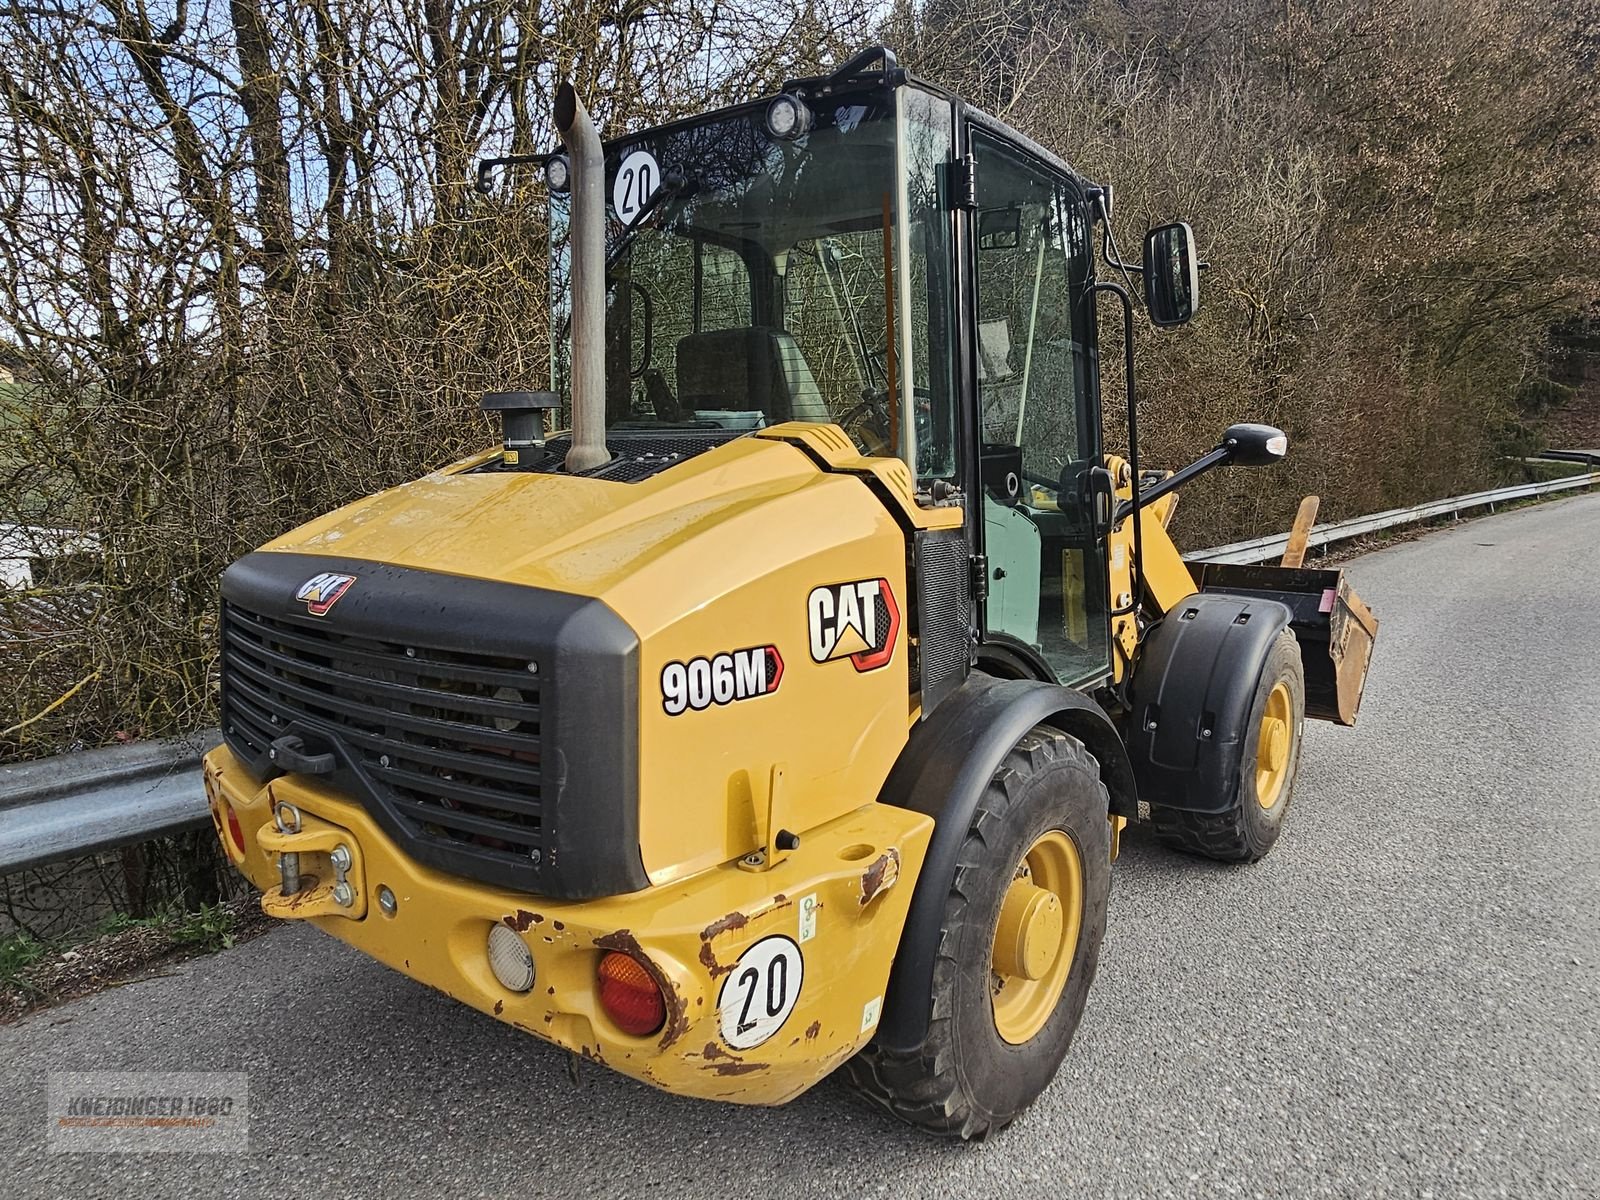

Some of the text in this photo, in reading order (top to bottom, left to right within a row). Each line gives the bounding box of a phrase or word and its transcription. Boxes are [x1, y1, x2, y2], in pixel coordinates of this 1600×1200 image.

[622, 164, 650, 214] 20
[298, 573, 350, 601] CAT
[808, 580, 880, 661] CAT
[662, 648, 768, 715] 906M
[737, 953, 788, 1036] 20
